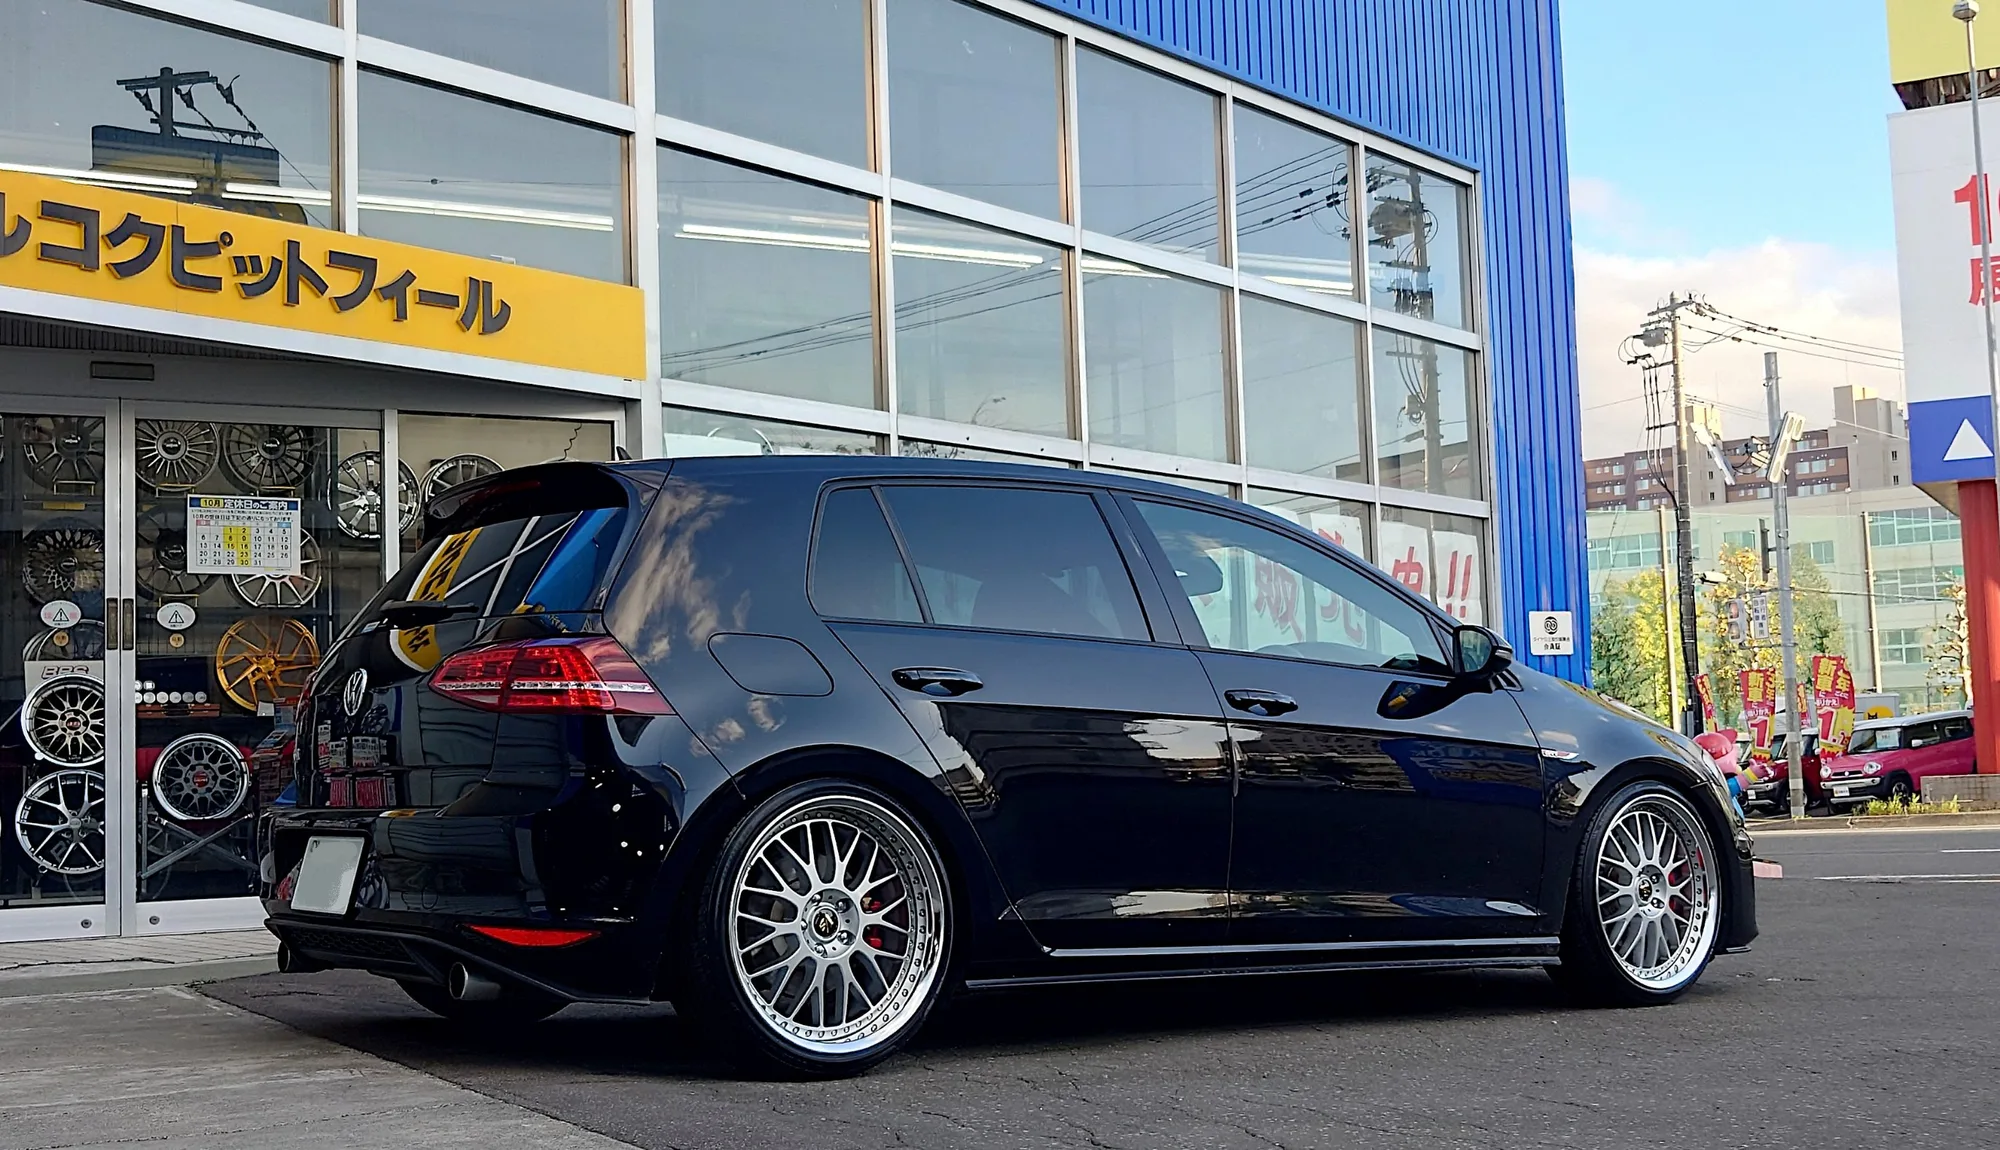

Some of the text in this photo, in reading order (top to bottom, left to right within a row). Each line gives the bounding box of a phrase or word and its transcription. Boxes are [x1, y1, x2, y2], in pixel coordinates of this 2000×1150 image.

[203, 499, 288, 510] 10月 定休日のご案内
